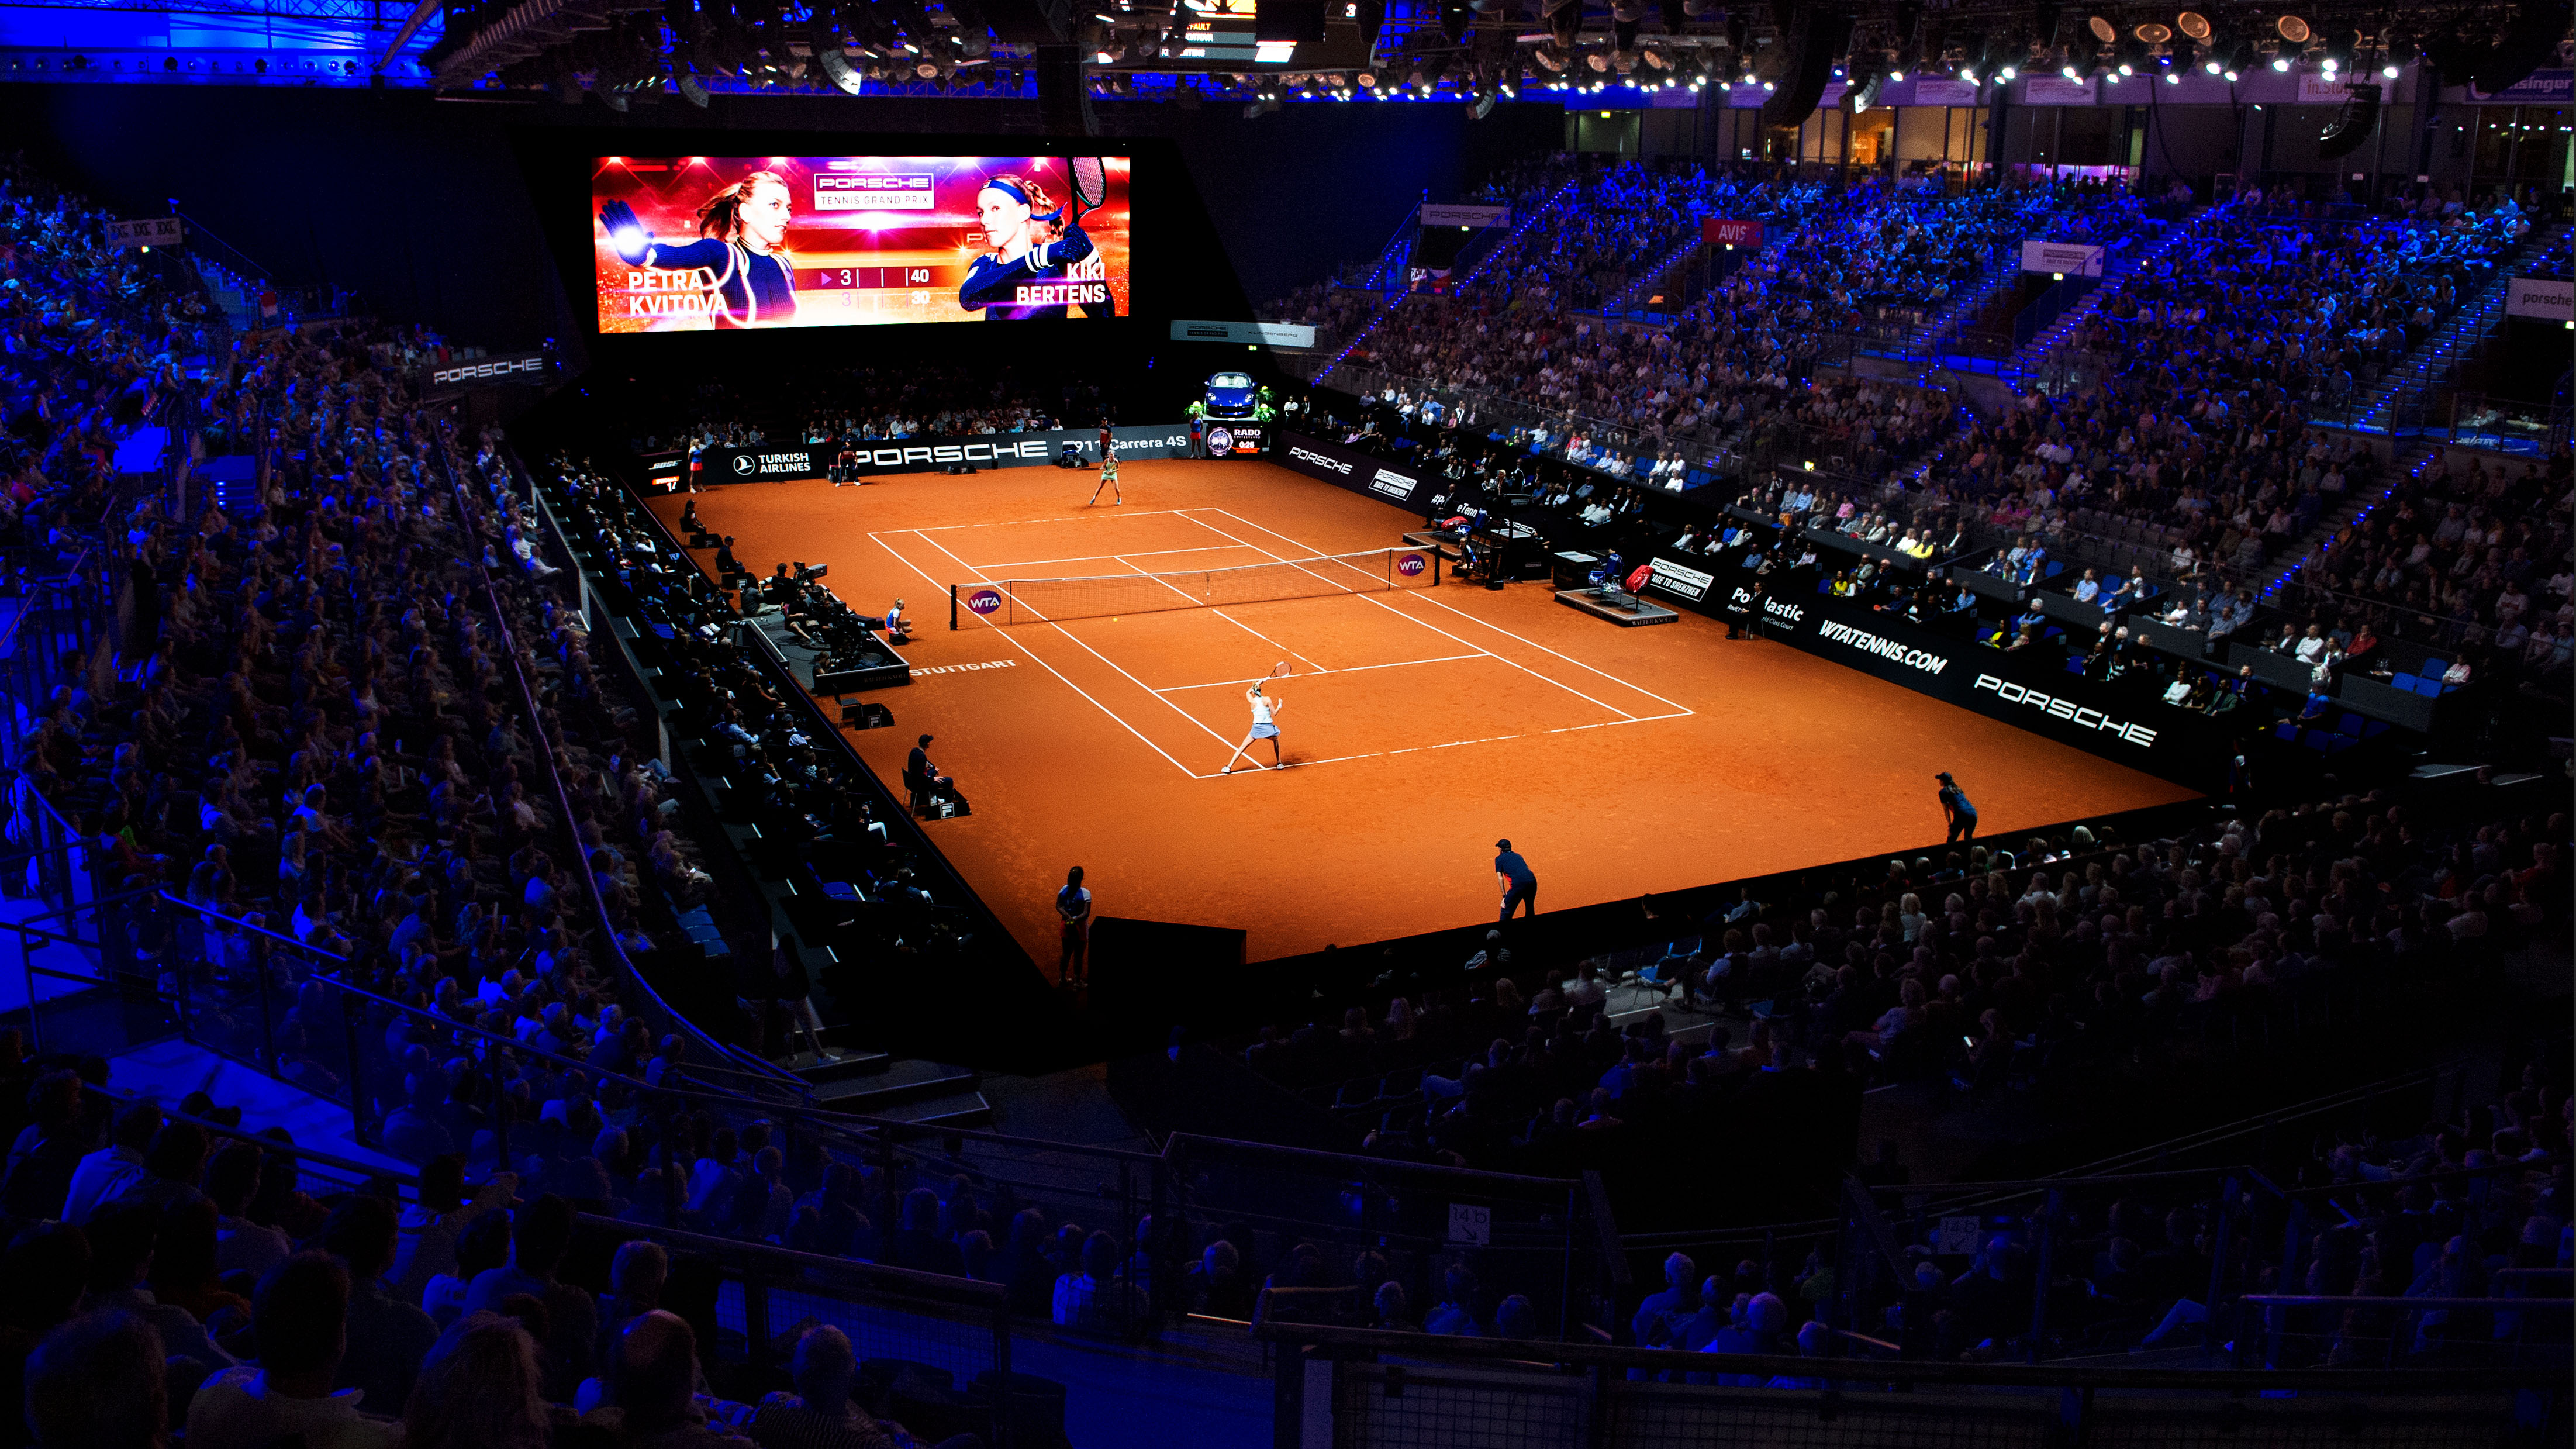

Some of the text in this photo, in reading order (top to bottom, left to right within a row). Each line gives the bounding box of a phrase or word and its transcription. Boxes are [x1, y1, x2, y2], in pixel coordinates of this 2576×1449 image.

[819, 178, 929, 188] PORSCHE
[821, 196, 859, 205] TENNIS
[1430, 211, 1500, 220] PORSCHE
[1718, 224, 1747, 240] AVIS
[840, 268, 930, 285] 3 40
[1067, 263, 1105, 281] KIKI
[629, 271, 703, 292] PETRA
[841, 290, 930, 307] 3 30
[1016, 284, 1106, 305] BERTENS
[2523, 293, 2572, 306] porsche
[630, 294, 729, 316] KVITOVA
[433, 357, 543, 385] PORSCHE
[1109, 439, 1163, 450] Carrera
[1166, 436, 1187, 447] 4S
[758, 453, 809, 464] TURKISH
[856, 440, 1048, 466] PORSCHE
[1289, 446, 1353, 475] PORSCHE
[650, 460, 680, 469] BOSE
[759, 462, 811, 474] AIRLINES
[1377, 471, 1415, 487] PORSCHE
[1399, 560, 1424, 570] WTA
[1652, 560, 1711, 584] PORSCHE
[1651, 574, 1665, 585] ACE
[1663, 578, 1673, 586] TO
[1670, 580, 1701, 597] SHENZHEN
[970, 597, 1000, 608] WTA
[1732, 586, 1804, 622] Polastic
[1819, 620, 1948, 675] WTATENNIS.COM
[910, 659, 1017, 677] STUTTGART
[1974, 674, 2157, 747] PORSCHE
